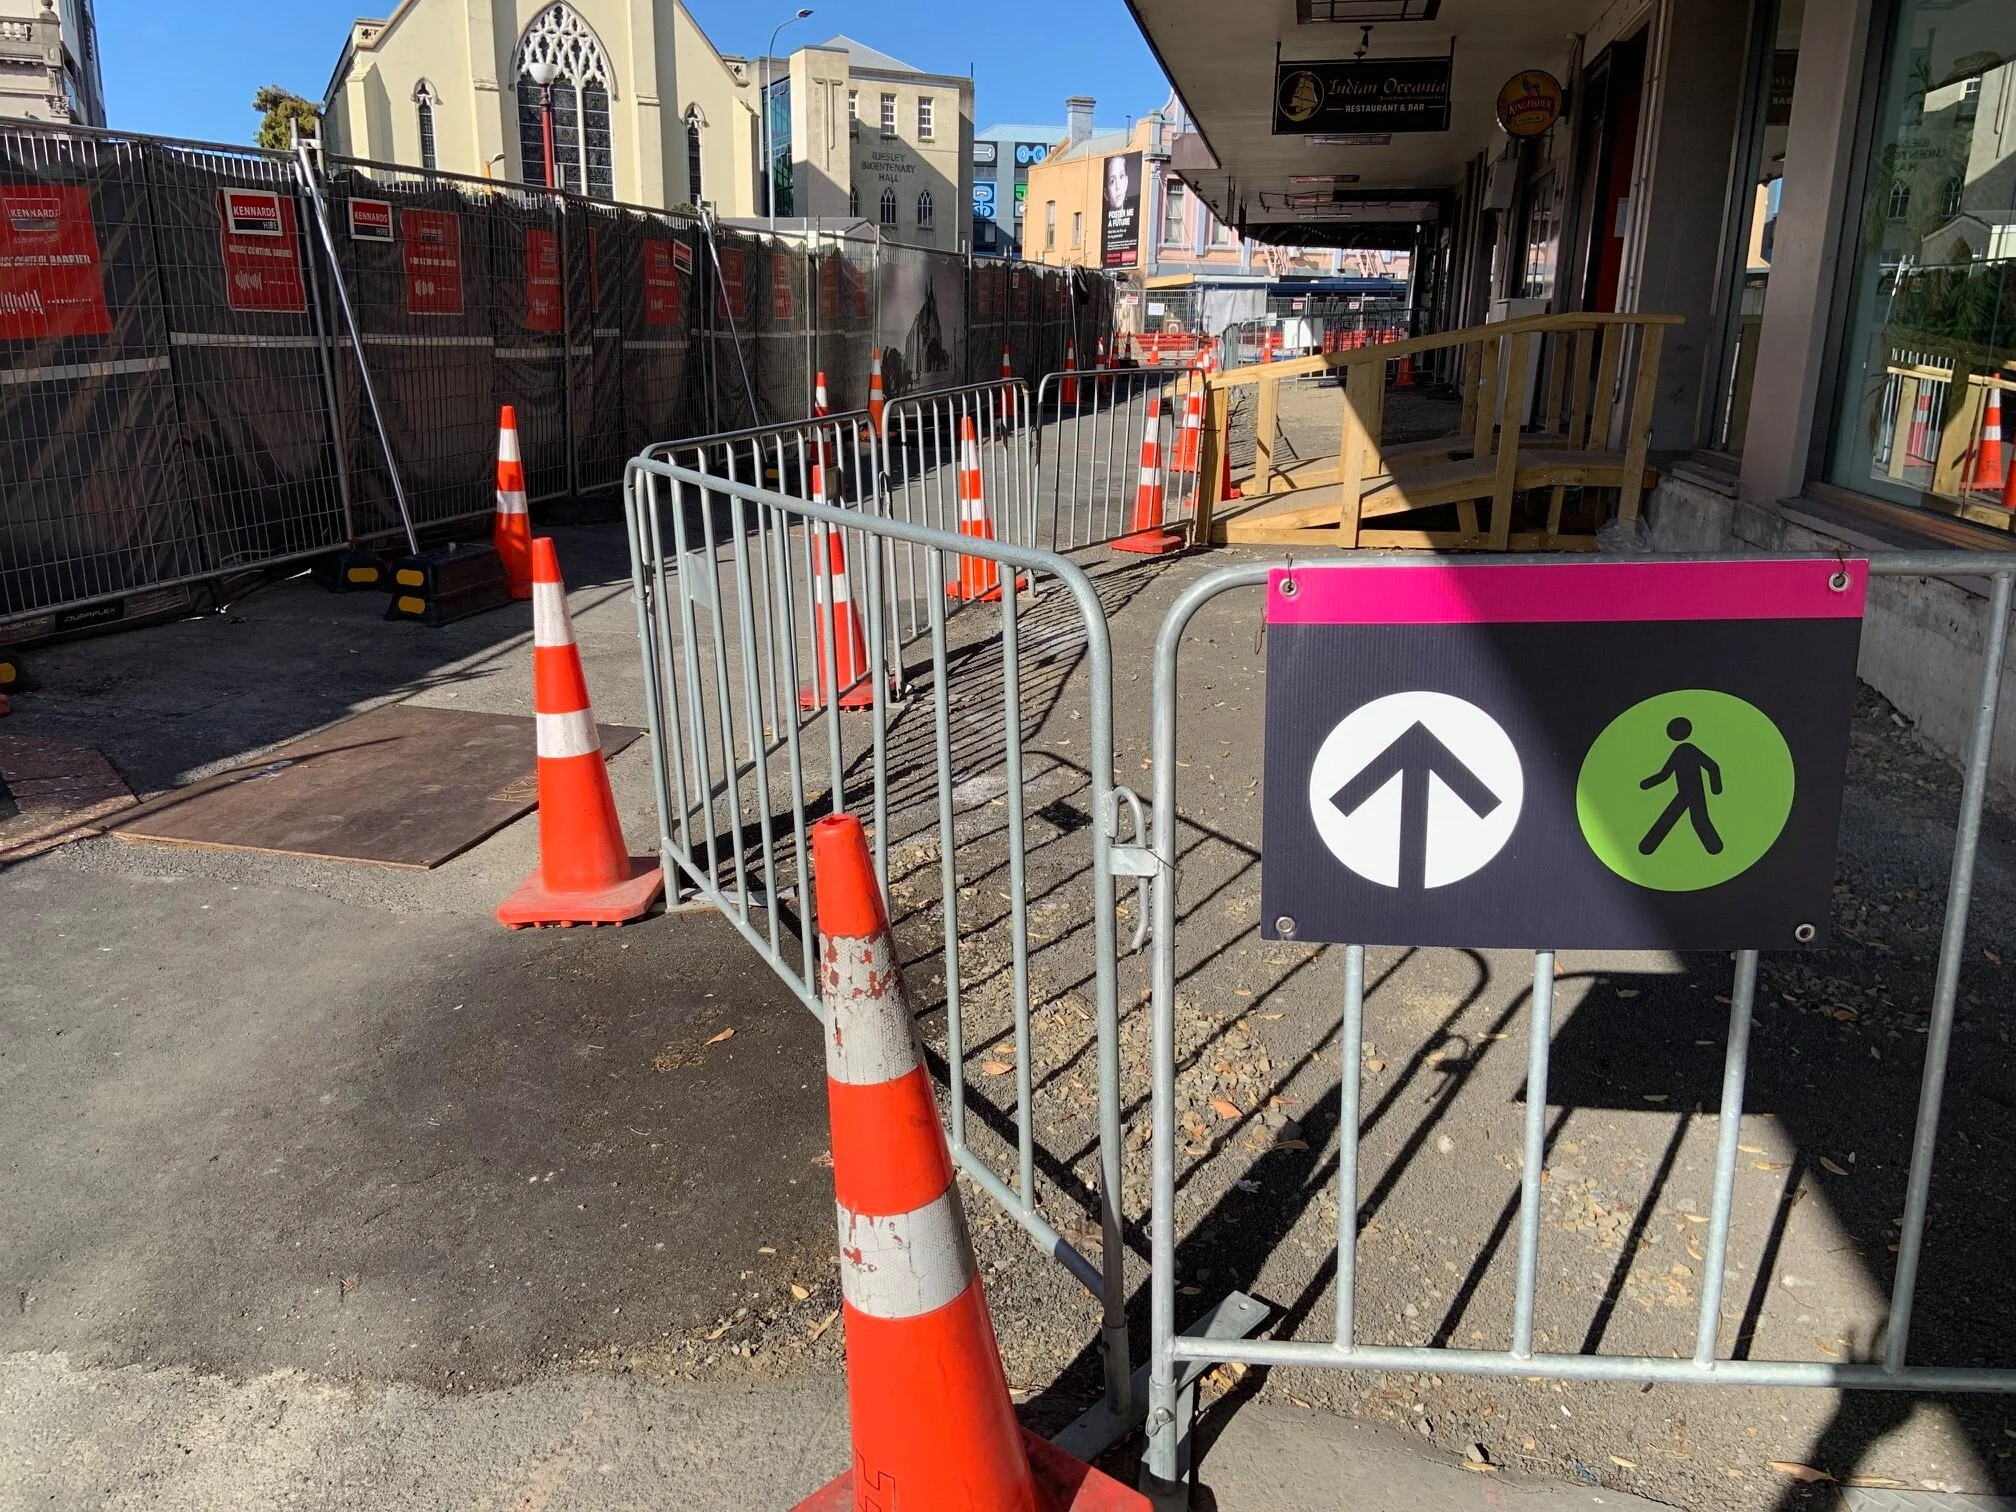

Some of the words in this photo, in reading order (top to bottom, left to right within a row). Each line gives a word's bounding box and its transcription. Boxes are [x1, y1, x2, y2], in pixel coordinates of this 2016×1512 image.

[1328, 77, 1378, 96] Indian
[1345, 103, 1399, 113] RESTAURANT
[1400, 103, 1406, 112] &
[1408, 102, 1425, 111] BAR
[1509, 99, 1552, 116] KINGFISHER
[872, 151, 906, 162] WESLEY
[861, 160, 916, 173] BICENTENARY
[878, 172, 900, 183] HALL
[233, 205, 276, 217] KENNARDS
[354, 211, 388, 223] KENNARDS
[262, 220, 278, 230] HIRE
[1107, 219, 1113, 227] A
[376, 227, 389, 236] HIRE
